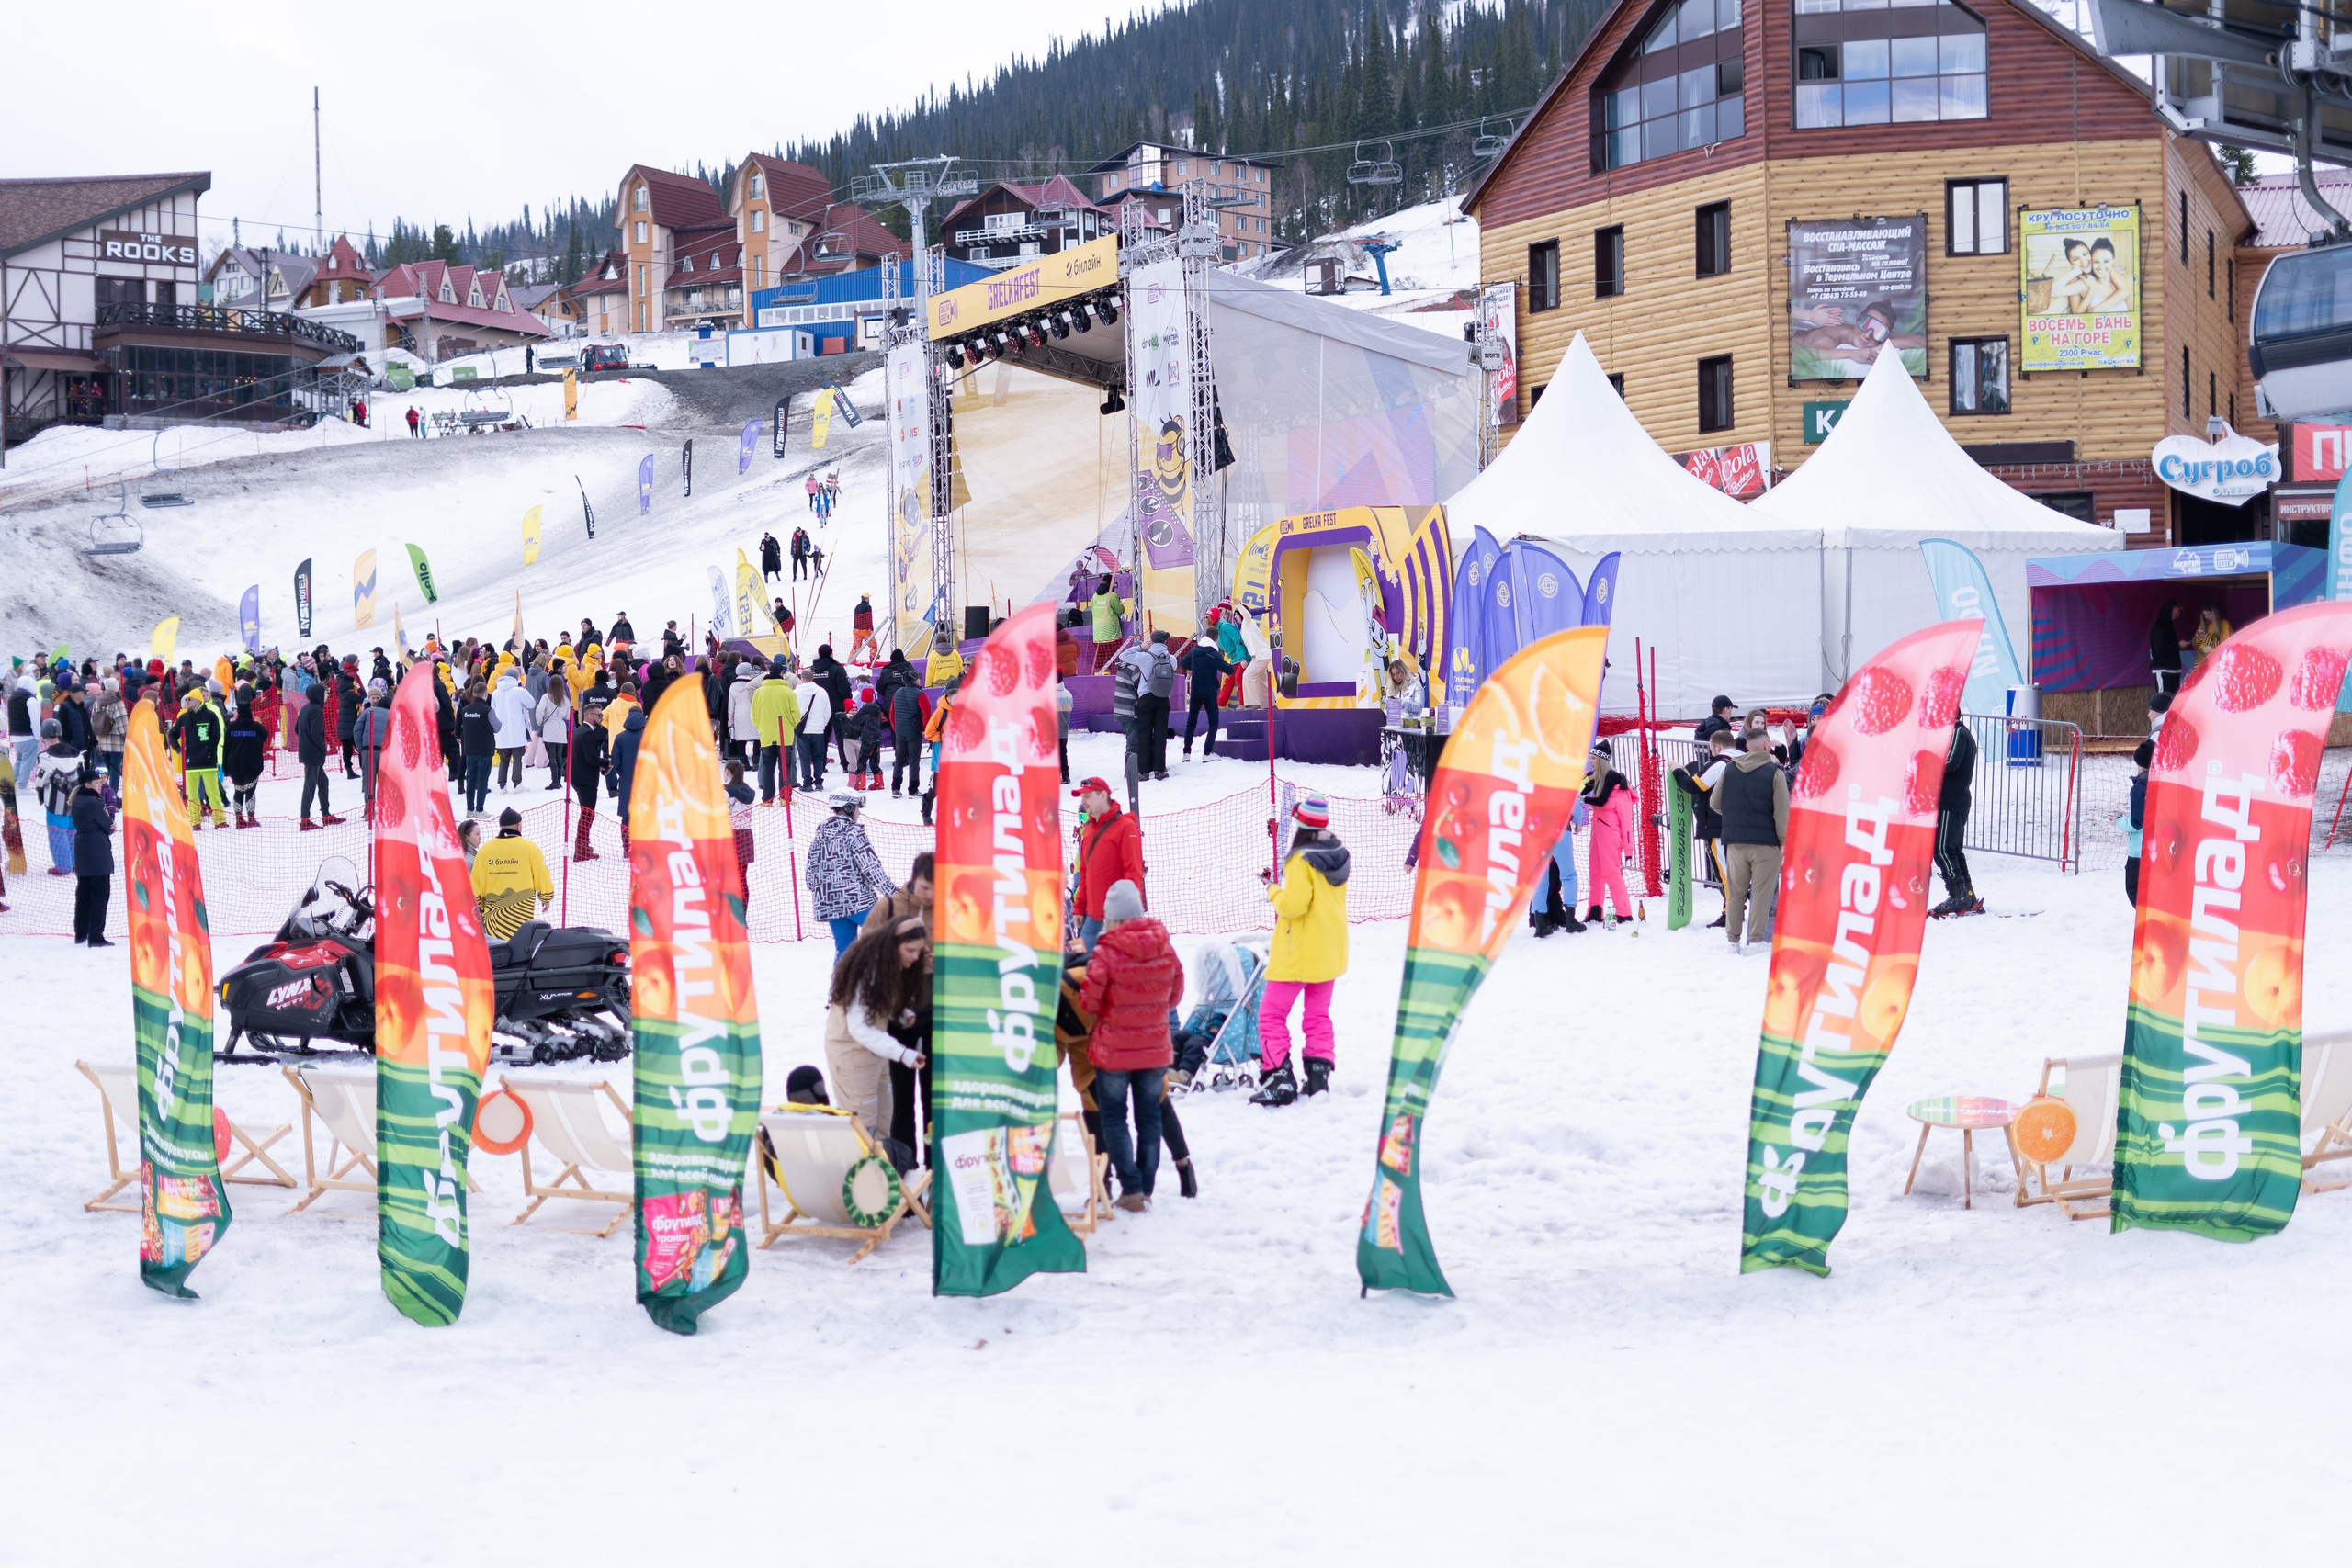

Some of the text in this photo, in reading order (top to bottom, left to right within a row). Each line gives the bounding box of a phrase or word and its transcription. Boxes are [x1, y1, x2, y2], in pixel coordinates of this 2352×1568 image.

[2028, 209, 2130, 222] КРУГЛОСУТОЧНО
[140, 234, 162, 243] THE
[1803, 226, 1912, 243] ВОССТАНАВЛИВАЮЩИЙ
[107, 241, 195, 263] ROOKS
[1827, 240, 1886, 253] СПА-МАССАЖ
[1074, 254, 1102, 276] билайн
[1804, 264, 1860, 274] Восстановись
[1881, 258, 1908, 266] склоне?
[1824, 271, 1878, 282] Термальном
[1880, 269, 1912, 279] Центре
[988, 268, 1040, 310] GRELKAFEST
[2029, 317, 2132, 332] ВОСЕМЬ БАНЬ
[2051, 332, 2110, 345] НА ГОРЕ
[2312, 430, 2352, 470] П
[1689, 449, 1712, 479] ola
[1721, 444, 1756, 481] Cola
[2159, 451, 2274, 485] Сугроб
[1303, 515, 1322, 529] GRELKA
[1323, 513, 1337, 527] FEST
[298, 573, 307, 604] HOTELS
[1678, 819, 1686, 917] SNOWBOARDS
[987, 724, 1037, 1074] фрутилад
[662, 805, 732, 1142] фрутилад
[2159, 770, 2265, 1180] фрутилад
[266, 977, 311, 1007] LYNX
[276, 997, 304, 1010] YETI
[952, 1096, 980, 1110] для
[676, 1168, 708, 1182] всей
